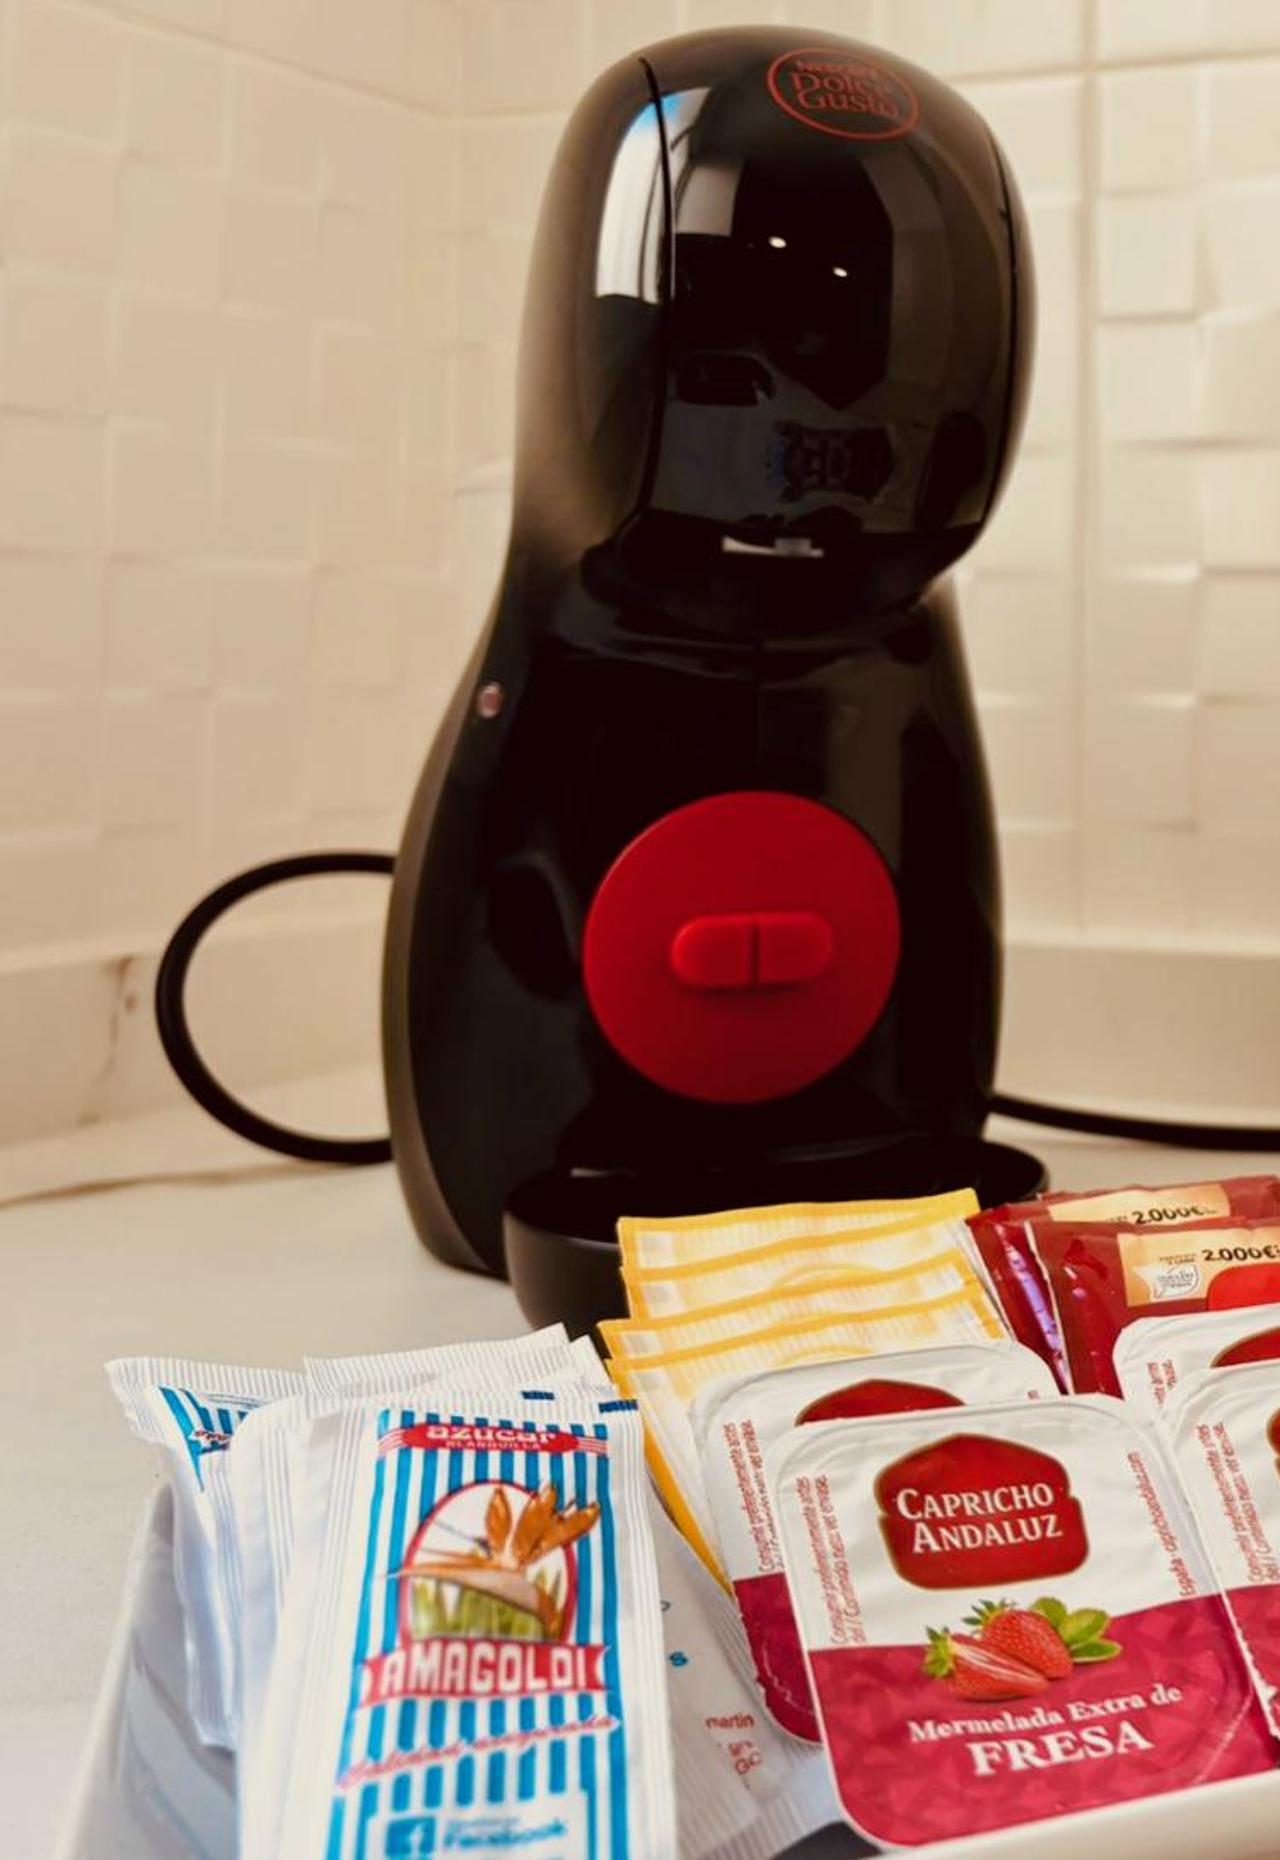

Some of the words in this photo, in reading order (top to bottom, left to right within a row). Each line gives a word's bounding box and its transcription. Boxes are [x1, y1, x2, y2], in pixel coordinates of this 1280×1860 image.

[896, 1483, 1055, 1520] CAPRICHO
[912, 1514, 1063, 1554] ANDALUZ
[380, 1642, 588, 1693] AMAGOLDI
[907, 1707, 1065, 1743] Mermelada
[1067, 1694, 1147, 1722] Extra
[1149, 1683, 1183, 1705] de
[967, 1720, 1154, 1776] FRESA
